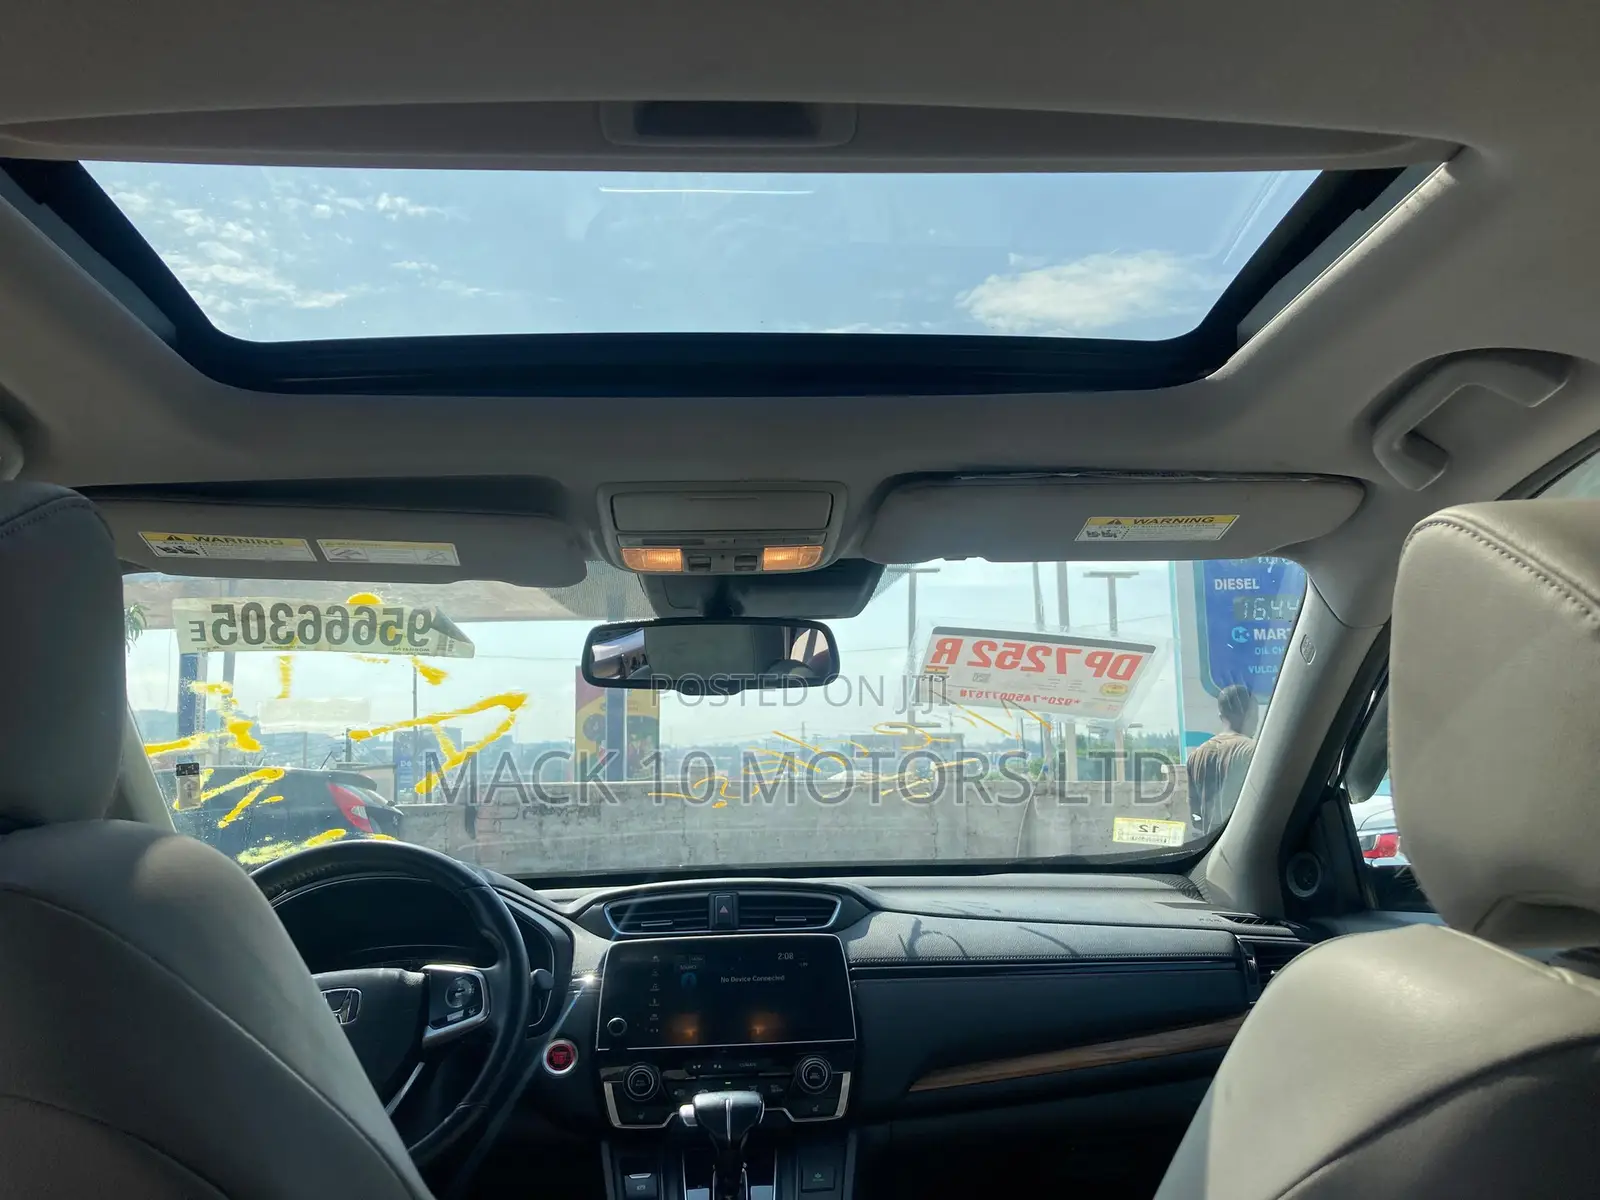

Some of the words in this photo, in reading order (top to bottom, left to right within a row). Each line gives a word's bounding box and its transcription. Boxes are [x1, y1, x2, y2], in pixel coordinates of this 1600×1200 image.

[1133, 516, 1215, 526] WARNING
[192, 534, 284, 546] WARNING
[1214, 578, 1260, 591] DIESEL
[1254, 646, 1270, 655] OIL
[777, 952, 794, 960] 2:08
[752, 974, 786, 982] Connected
